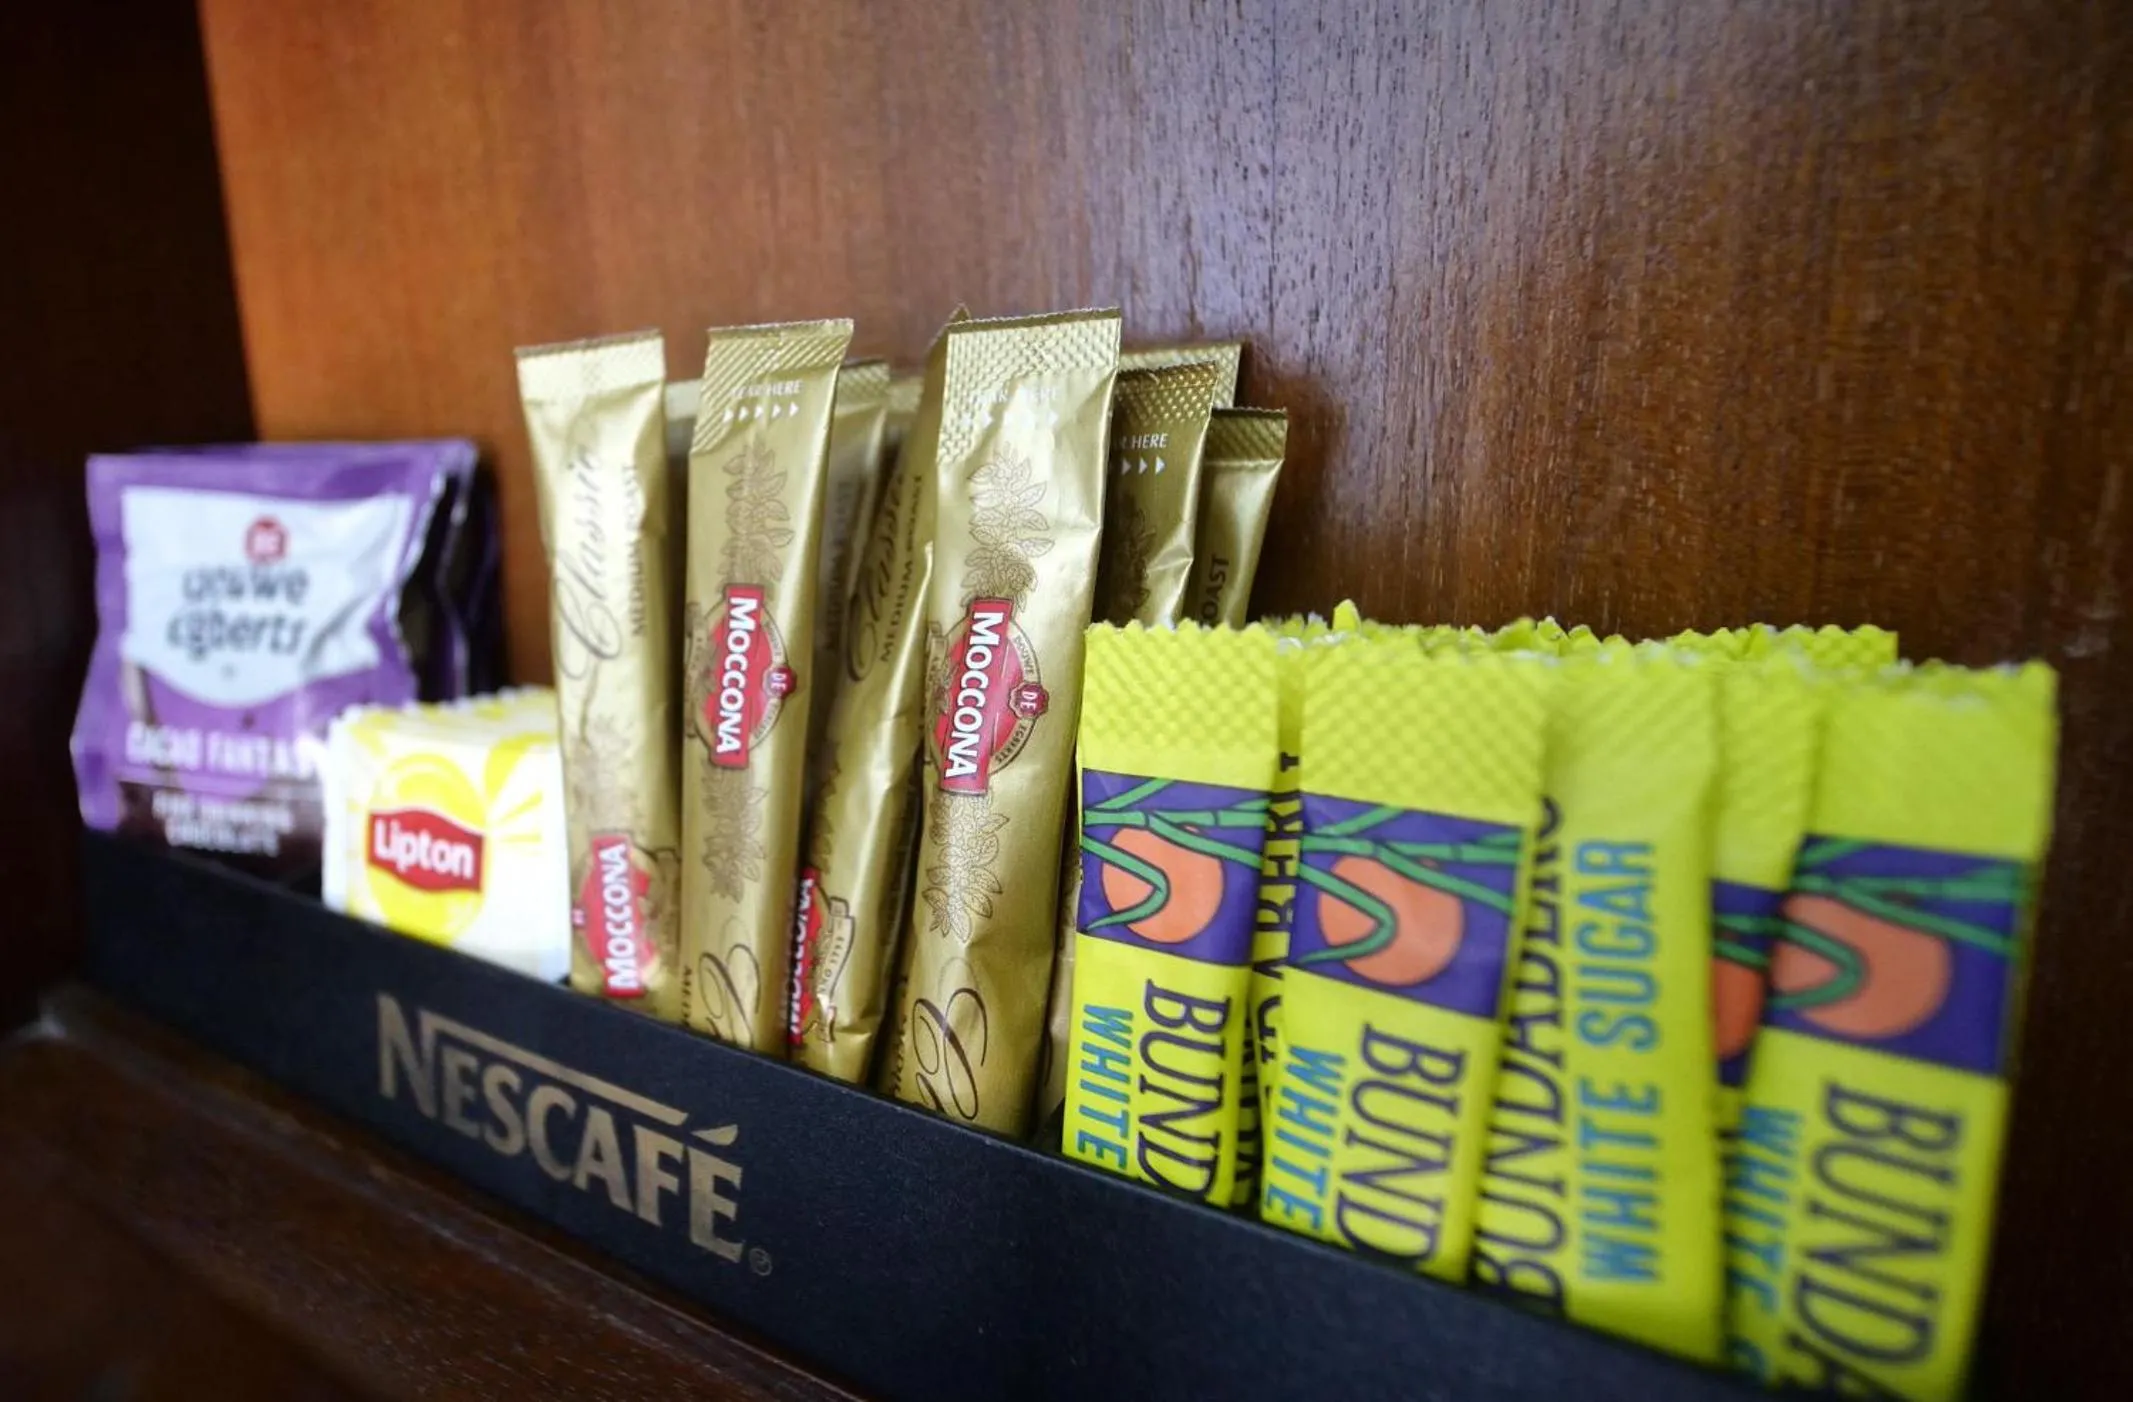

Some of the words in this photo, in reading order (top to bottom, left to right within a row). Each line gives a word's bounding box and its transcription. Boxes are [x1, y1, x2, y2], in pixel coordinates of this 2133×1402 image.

[767, 379, 804, 396] HERE
[1131, 433, 1169, 449] HERE
[1201, 553, 1229, 622] OAST
[716, 597, 758, 753] MOCCONA
[945, 611, 1004, 778] MOCCONA
[1021, 689, 1037, 713] DE
[375, 818, 475, 881] Lipton
[598, 842, 640, 989] MOCCONA
[1573, 840, 1660, 1051] SUGAR
[375, 992, 746, 1263] NESCAFÉ
[1076, 1003, 1134, 1169] WHITE
[1137, 978, 1232, 1200] BUND
[1265, 1045, 1347, 1231] WHITE
[1336, 1021, 1470, 1262] BUND
[1578, 1074, 1662, 1285] WHITE
